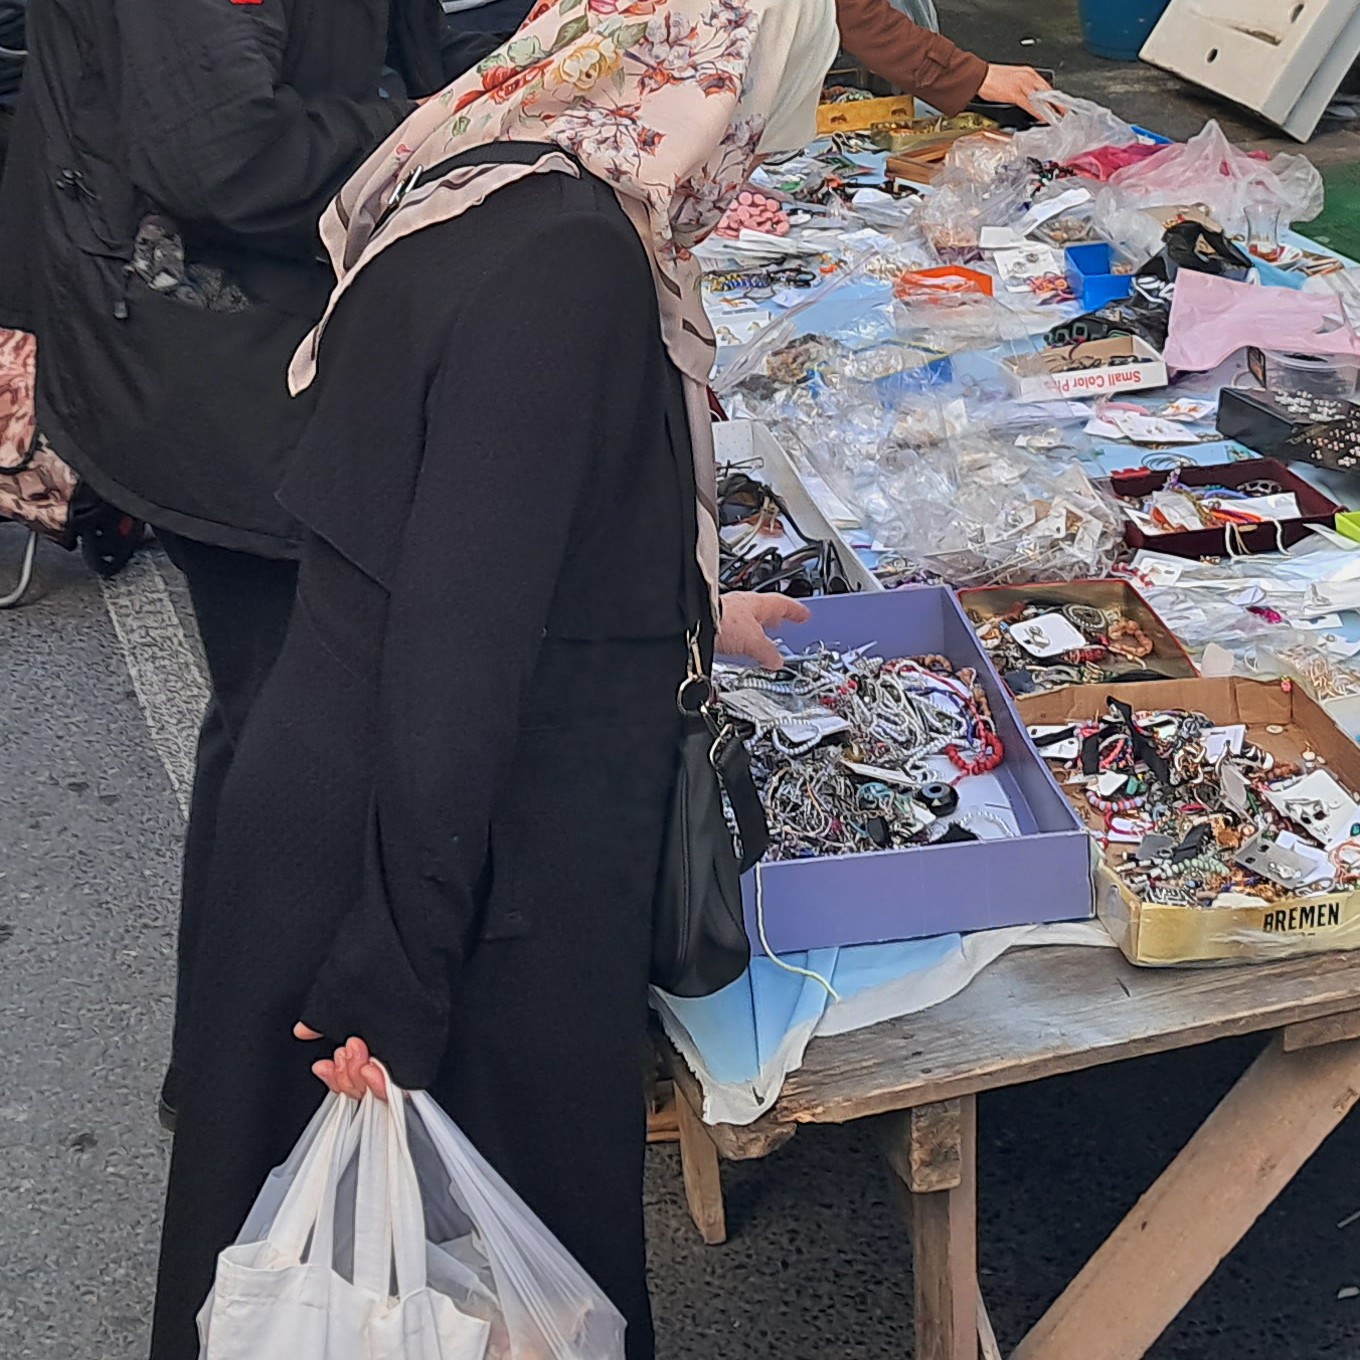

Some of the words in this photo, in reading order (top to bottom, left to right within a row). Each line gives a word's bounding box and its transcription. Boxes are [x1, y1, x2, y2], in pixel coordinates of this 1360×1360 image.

[1073, 374, 1105, 389] Color
[1107, 370, 1142, 387] Small
[1263, 902, 1340, 933] BREMEN
